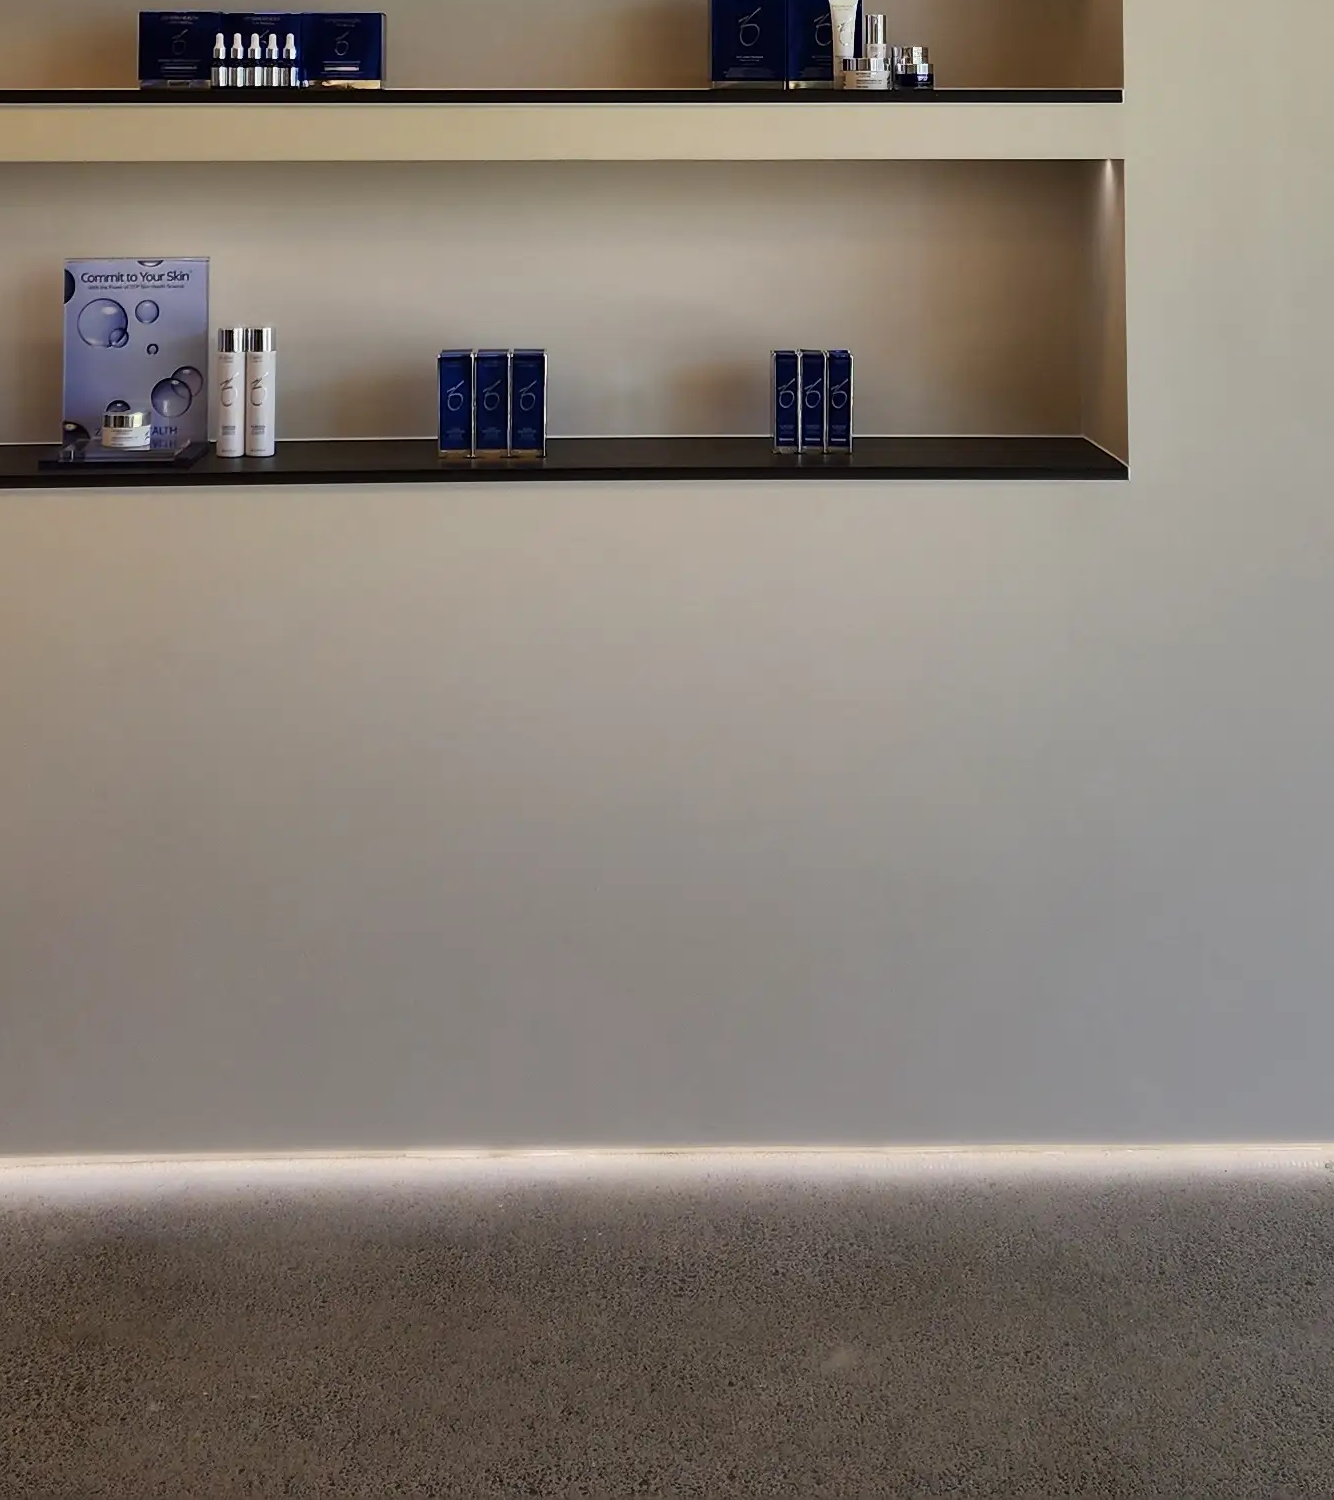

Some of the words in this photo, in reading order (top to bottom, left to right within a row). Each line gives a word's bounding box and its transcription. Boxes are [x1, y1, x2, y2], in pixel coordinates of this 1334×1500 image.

[81, 271, 125, 283] Commit
[127, 273, 138, 282] to
[139, 272, 165, 282] Your
[166, 271, 189, 281] Skin
[151, 426, 178, 435] ALTH
